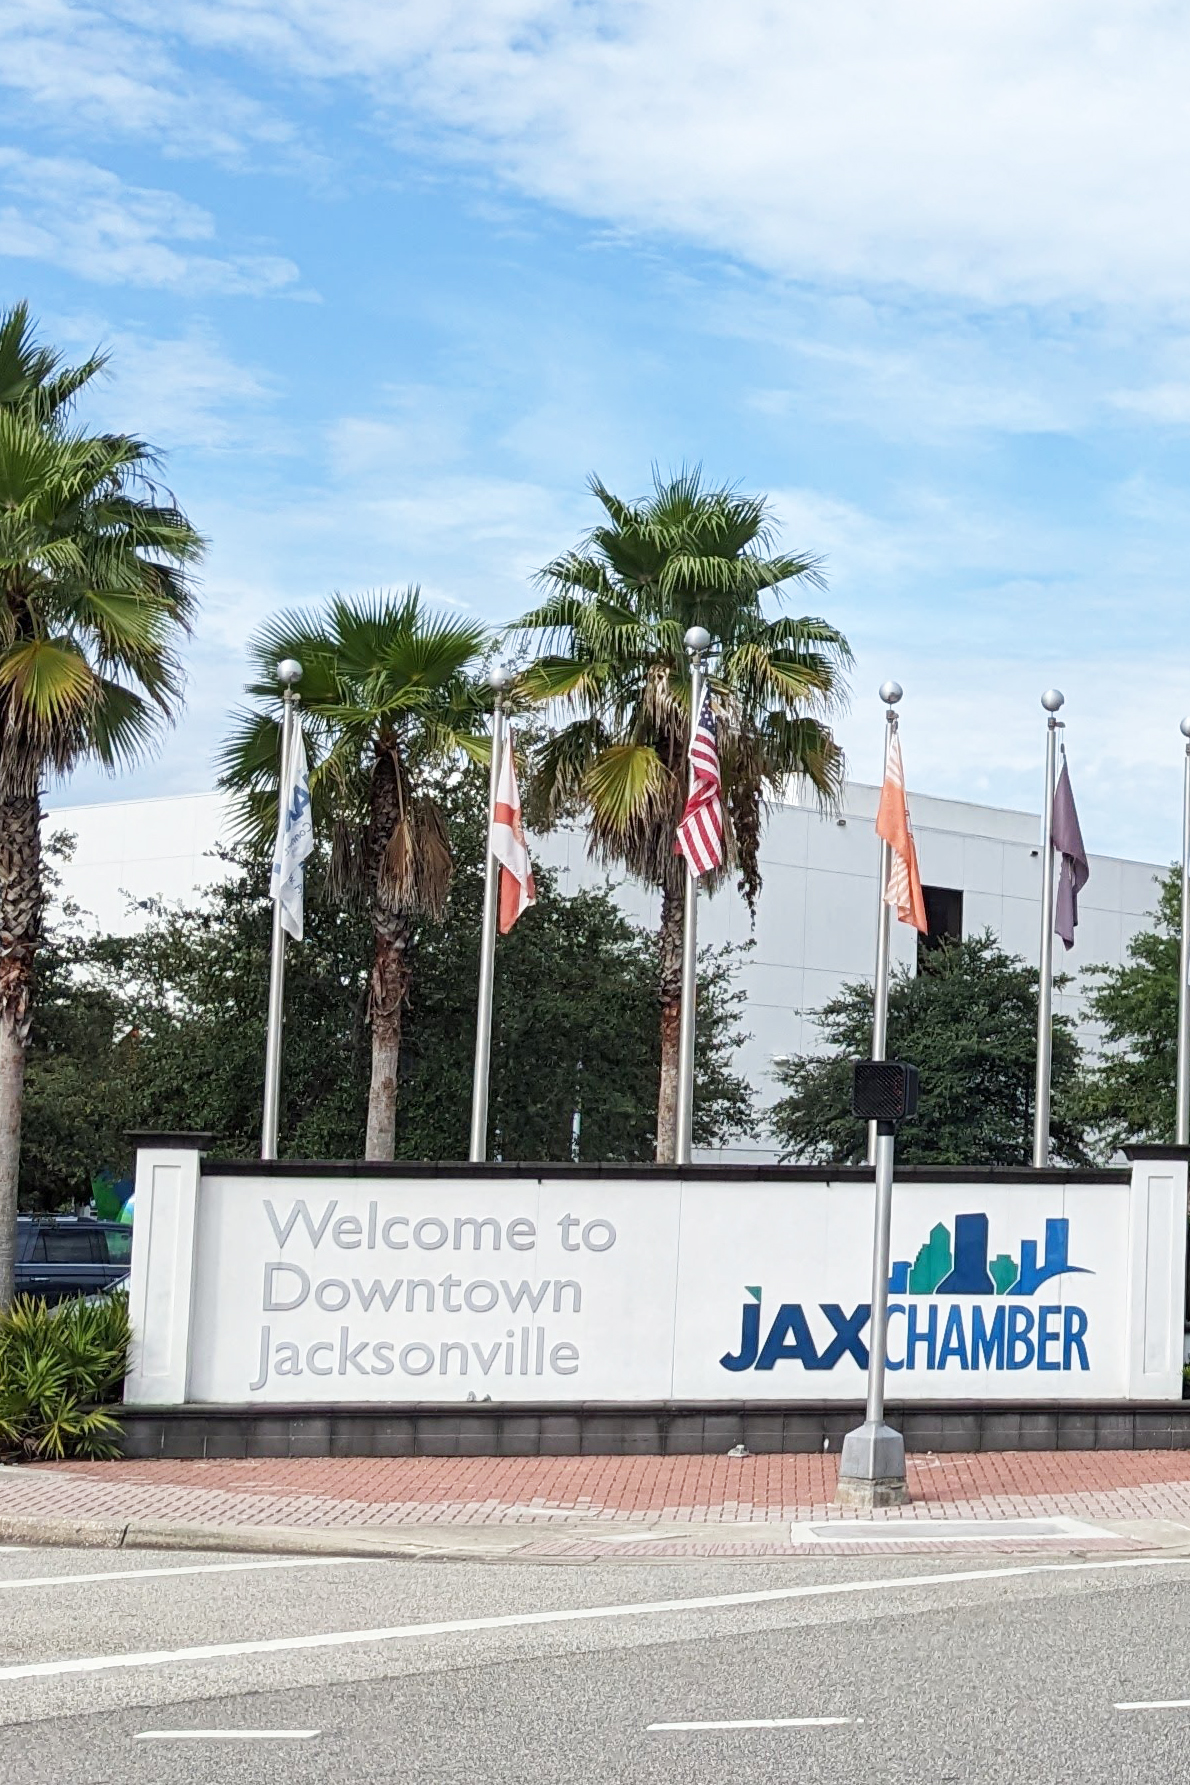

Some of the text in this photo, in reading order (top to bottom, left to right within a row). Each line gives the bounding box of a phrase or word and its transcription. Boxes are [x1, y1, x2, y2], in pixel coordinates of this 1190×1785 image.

[263, 1200, 617, 1252] Welcome to
[263, 1262, 581, 1313] Downtown
[249, 1325, 579, 1391] Jacksonville
